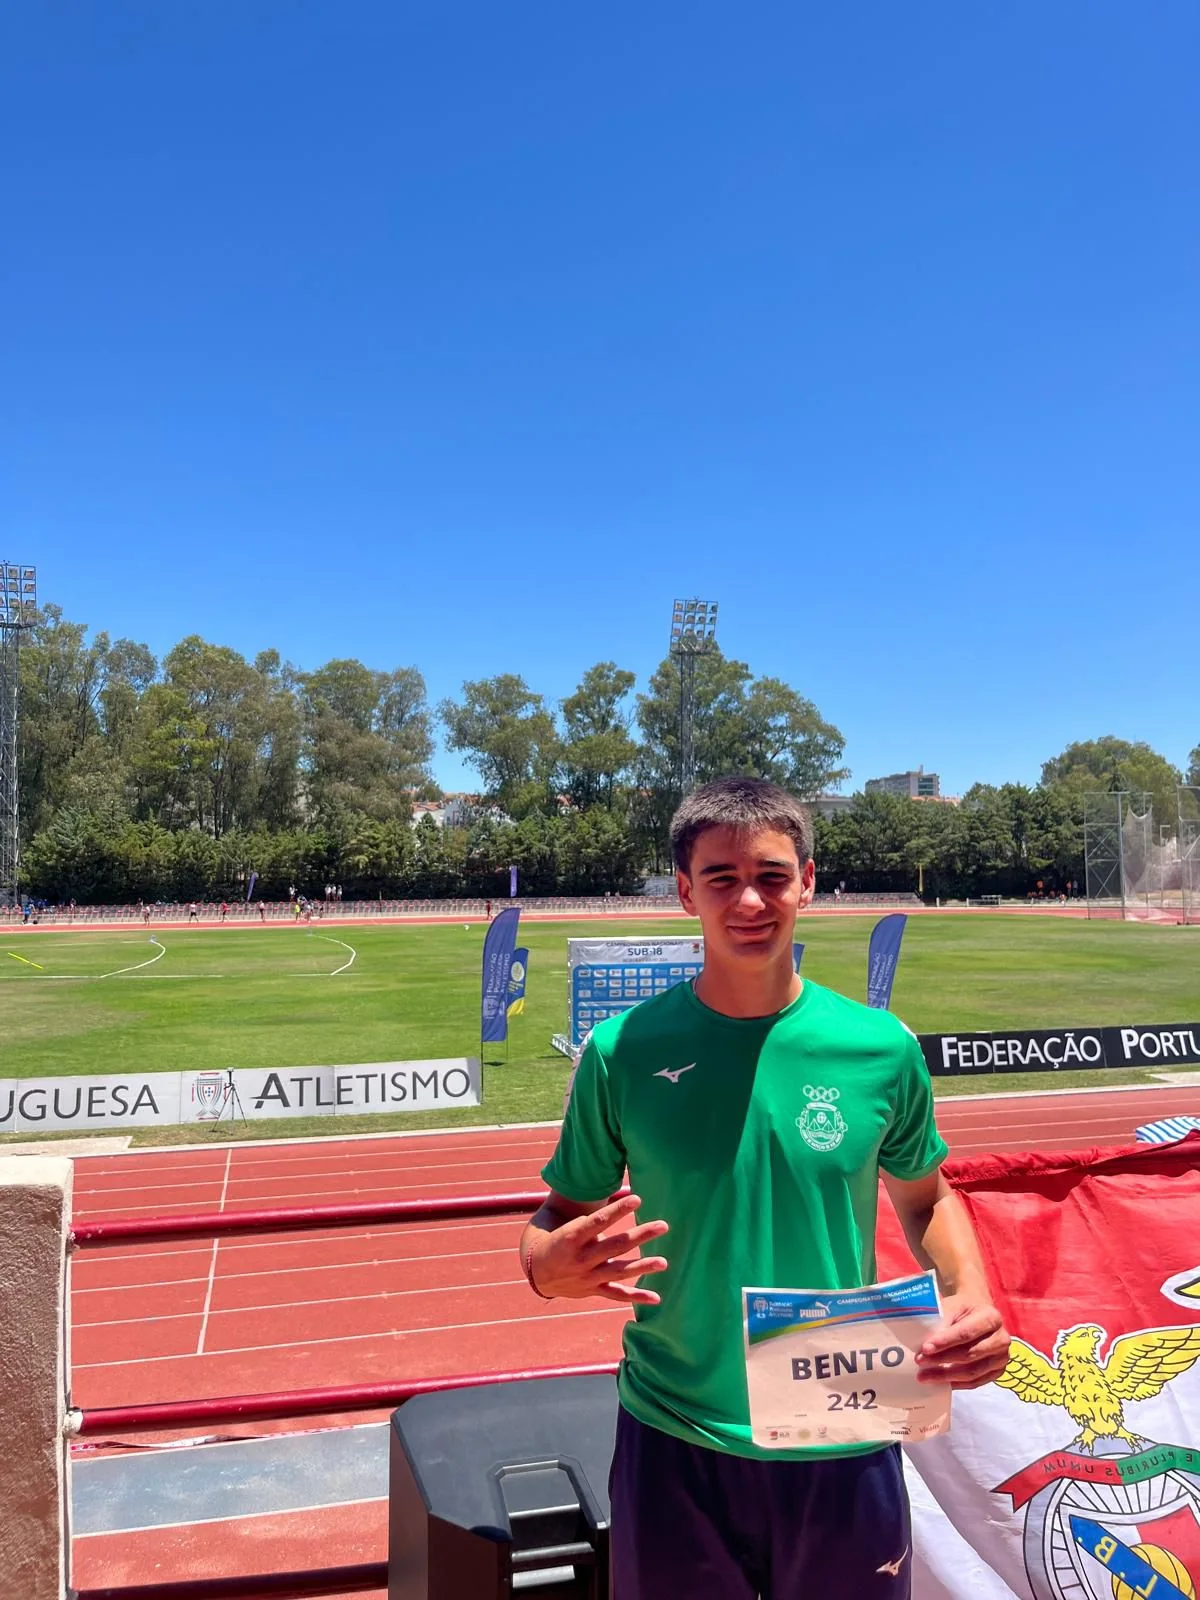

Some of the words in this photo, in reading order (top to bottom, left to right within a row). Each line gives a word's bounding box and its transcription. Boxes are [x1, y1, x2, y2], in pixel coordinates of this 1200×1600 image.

[627, 947, 662, 956] SUB-18
[941, 1032, 1102, 1069] FEDERAÇÃO
[249, 1068, 471, 1109] ATLETISMO
[799, 1308, 826, 1318] PUMA
[791, 1346, 905, 1380] BENTO
[827, 1388, 878, 1411] 242
